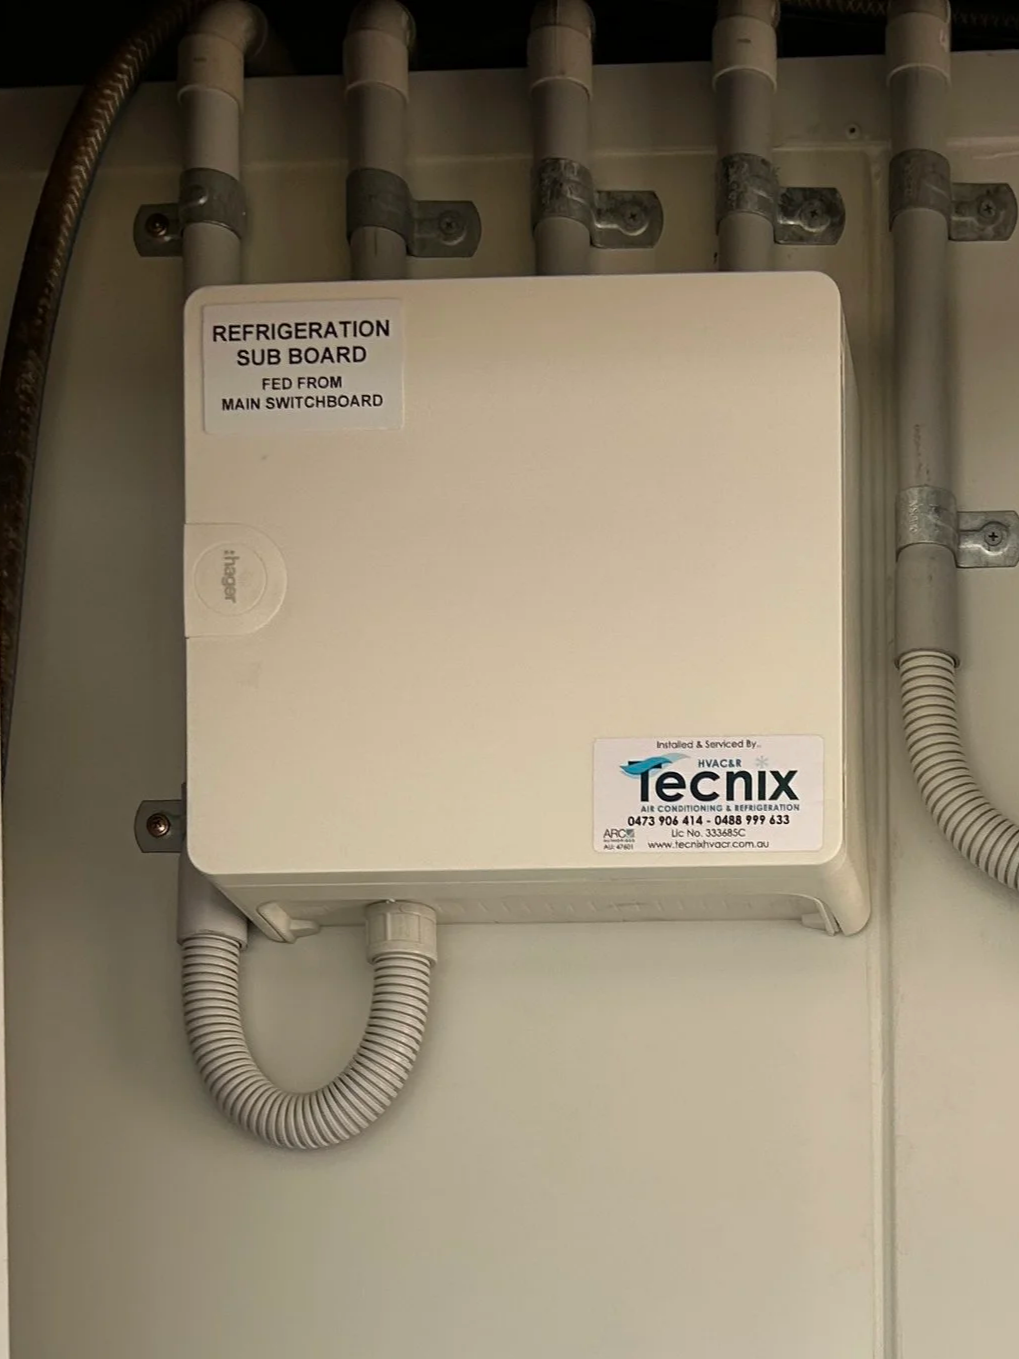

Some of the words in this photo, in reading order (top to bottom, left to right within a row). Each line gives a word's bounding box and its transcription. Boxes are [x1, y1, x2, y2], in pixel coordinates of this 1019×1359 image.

[213, 319, 390, 342] REFRIGERATION
[237, 349, 281, 366] SUB
[289, 346, 367, 365] BOARD
[262, 378, 292, 390] FED
[297, 376, 342, 389] FROM
[222, 398, 261, 411] MAIN
[265, 394, 384, 410] SWITCHBOARD
[657, 740, 693, 749] Installed
[696, 740, 703, 749] &
[705, 739, 744, 749] Serviced
[698, 759, 742, 768] HVAC&R
[625, 758, 799, 802] Tecnix
[641, 805, 655, 813] AIR
[657, 804, 723, 813] CONDITIONING
[726, 804, 732, 812] &
[734, 803, 800, 812] REFRIGERATION
[627, 815, 655, 826] 0473
[658, 815, 679, 826] 906
[682, 815, 703, 826] 414
[714, 814, 742, 826] 0488
[745, 814, 766, 825] 999
[769, 814, 790, 825] 633
[603, 828, 627, 838] ARC
[671, 829, 684, 838] Lic
[687, 829, 703, 838] No.
[647, 840, 769, 849] www.tecnixhvacr.com.au
